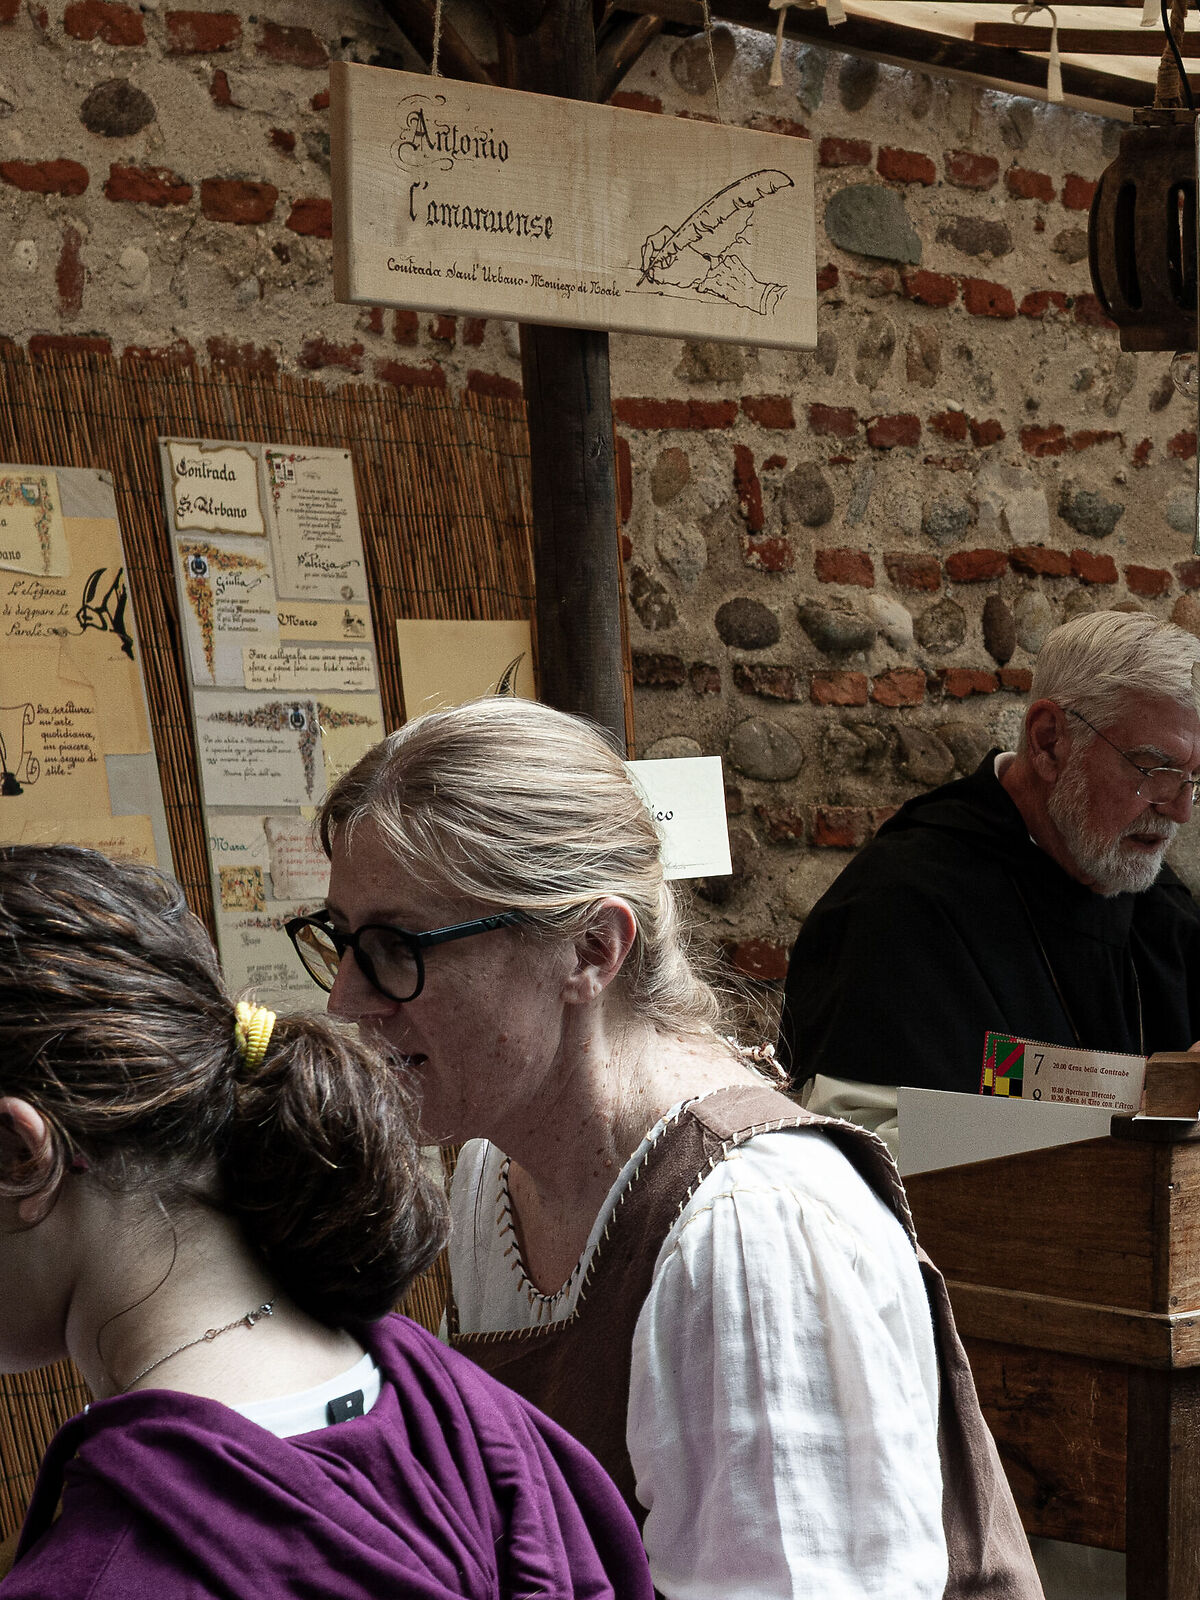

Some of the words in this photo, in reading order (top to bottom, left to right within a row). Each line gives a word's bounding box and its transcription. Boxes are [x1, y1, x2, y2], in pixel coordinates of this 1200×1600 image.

[392, 104, 509, 168] Antonio
[387, 257, 441, 277] Contrada
[482, 266, 523, 285] Urbano
[578, 281, 588, 293] di
[176, 457, 236, 481] Contrada
[194, 496, 247, 518] Urbano
[216, 574, 255, 595] Giulia
[277, 613, 318, 627] Marco
[87, 749, 98, 762] di
[210, 837, 248, 851] Mara
[1034, 1053, 1045, 1075] 7
[1091, 1090, 1116, 1100] Mercato
